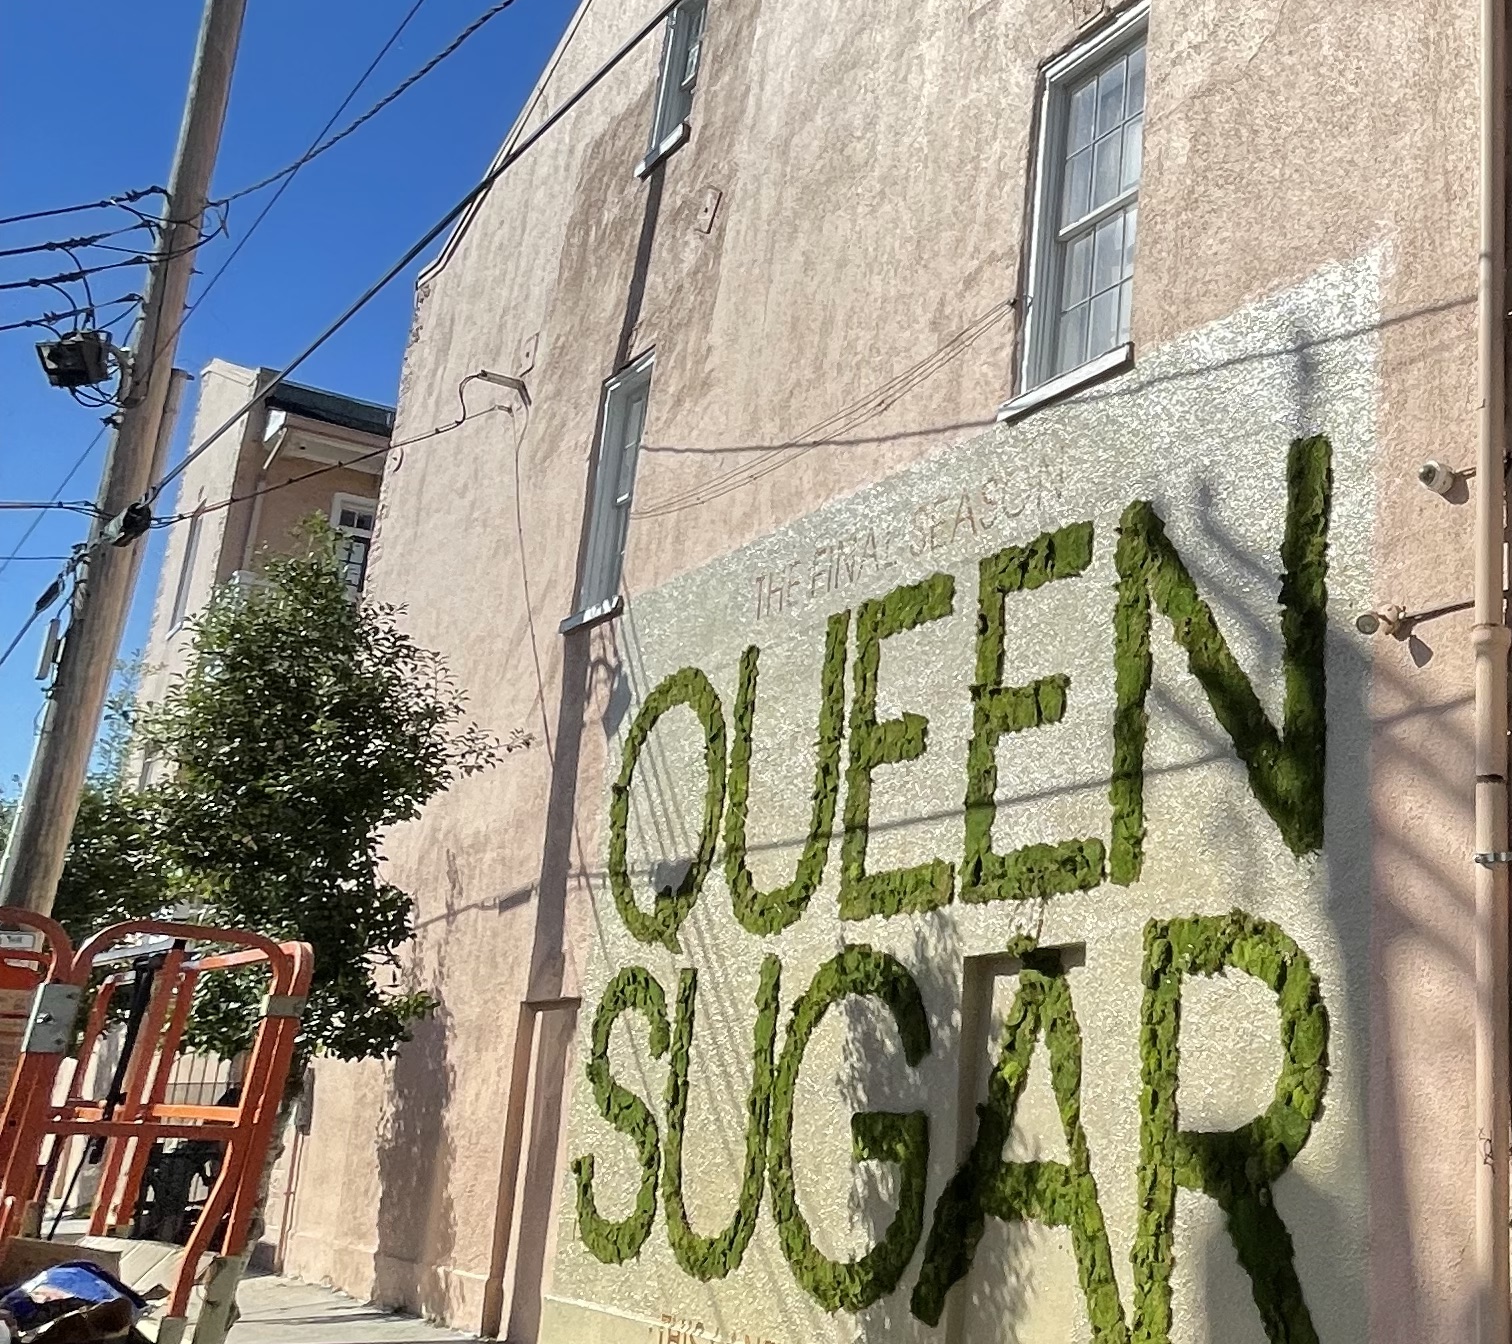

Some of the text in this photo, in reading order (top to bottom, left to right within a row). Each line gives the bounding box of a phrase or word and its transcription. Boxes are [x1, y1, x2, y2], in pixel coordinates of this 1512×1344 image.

[612, 435, 1332, 952] QUEEN
[756, 558, 801, 621] THE
[810, 528, 899, 601] FINAL
